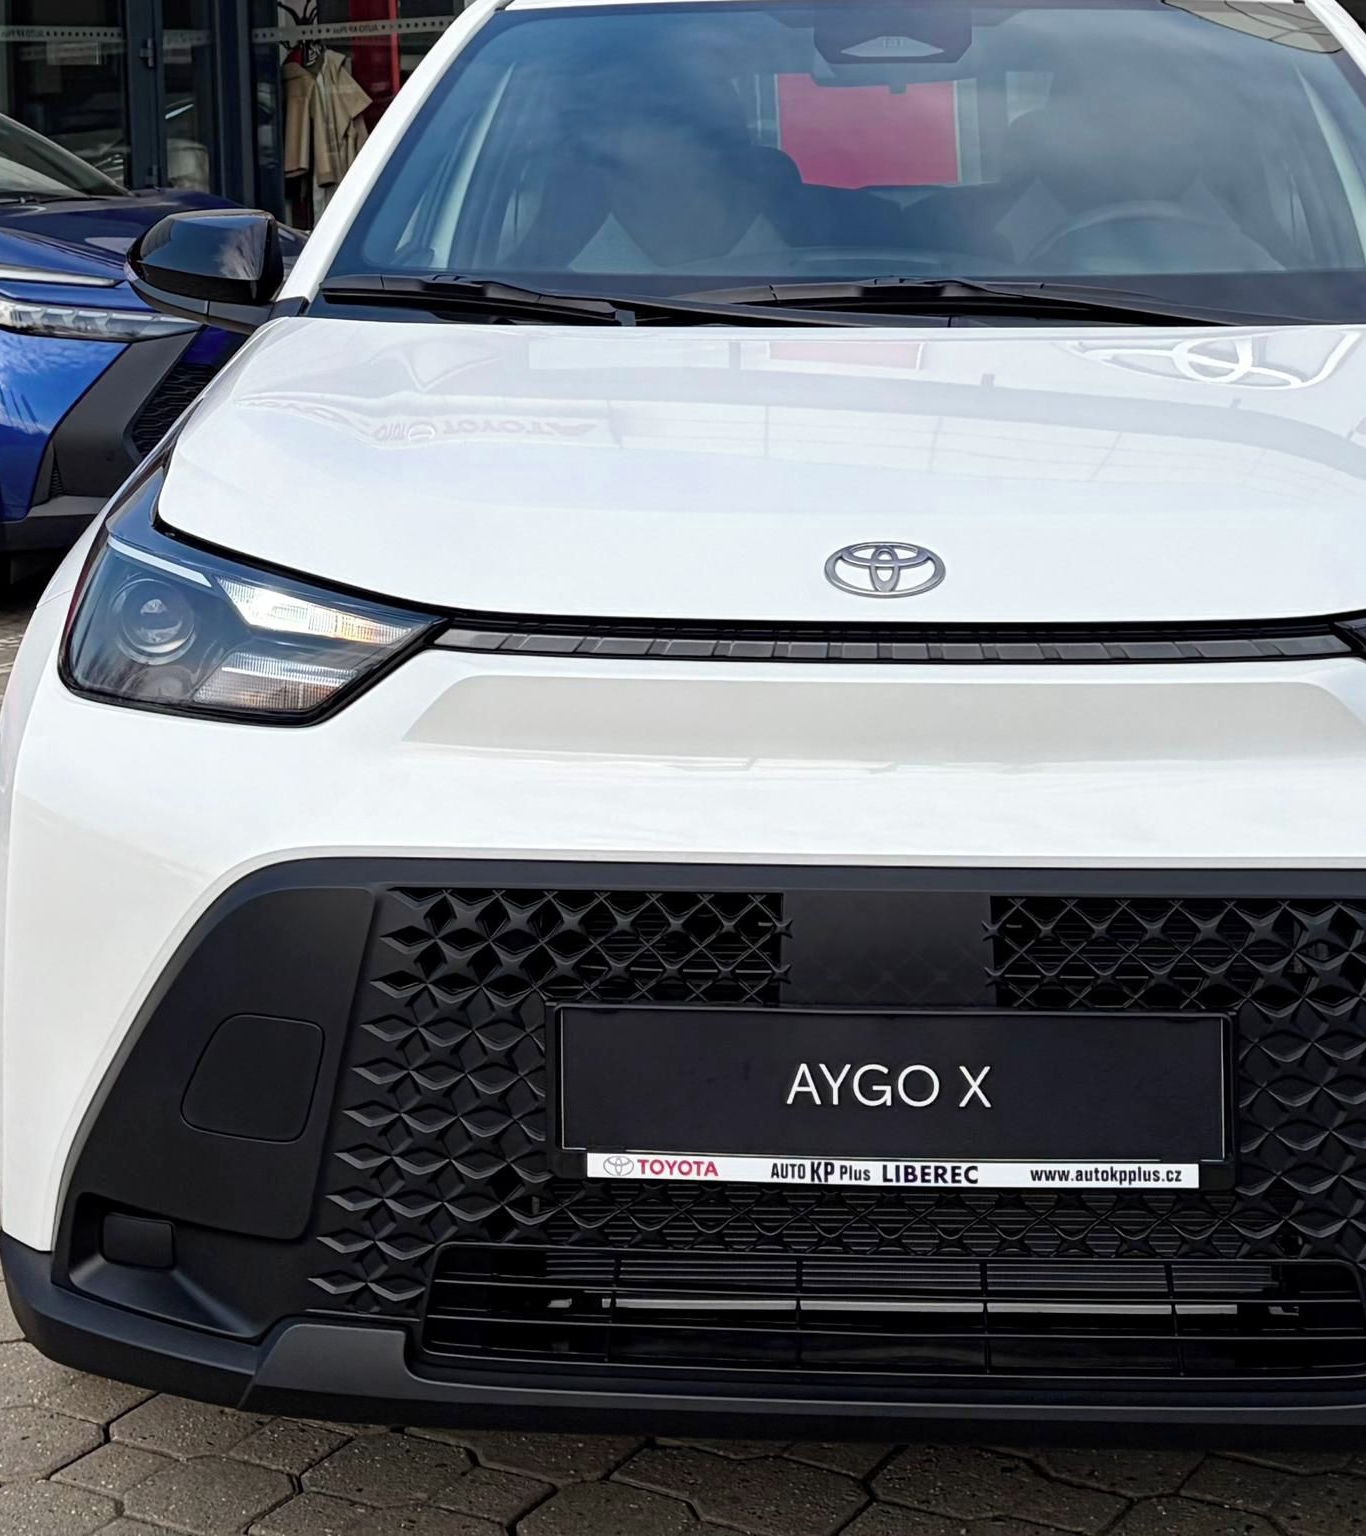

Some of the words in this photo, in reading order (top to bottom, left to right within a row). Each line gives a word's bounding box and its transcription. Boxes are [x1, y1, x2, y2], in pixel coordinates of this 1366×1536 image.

[786, 1062, 940, 1108] AYGO
[958, 1065, 992, 1109] X
[637, 1158, 719, 1177] TOYOTA
[770, 1162, 806, 1180] AUTO
[810, 1160, 835, 1184] KP
[839, 1164, 871, 1182] Plus
[882, 1164, 979, 1185] LIBEREC
[1030, 1166, 1183, 1186] www.autokpplus.cz
